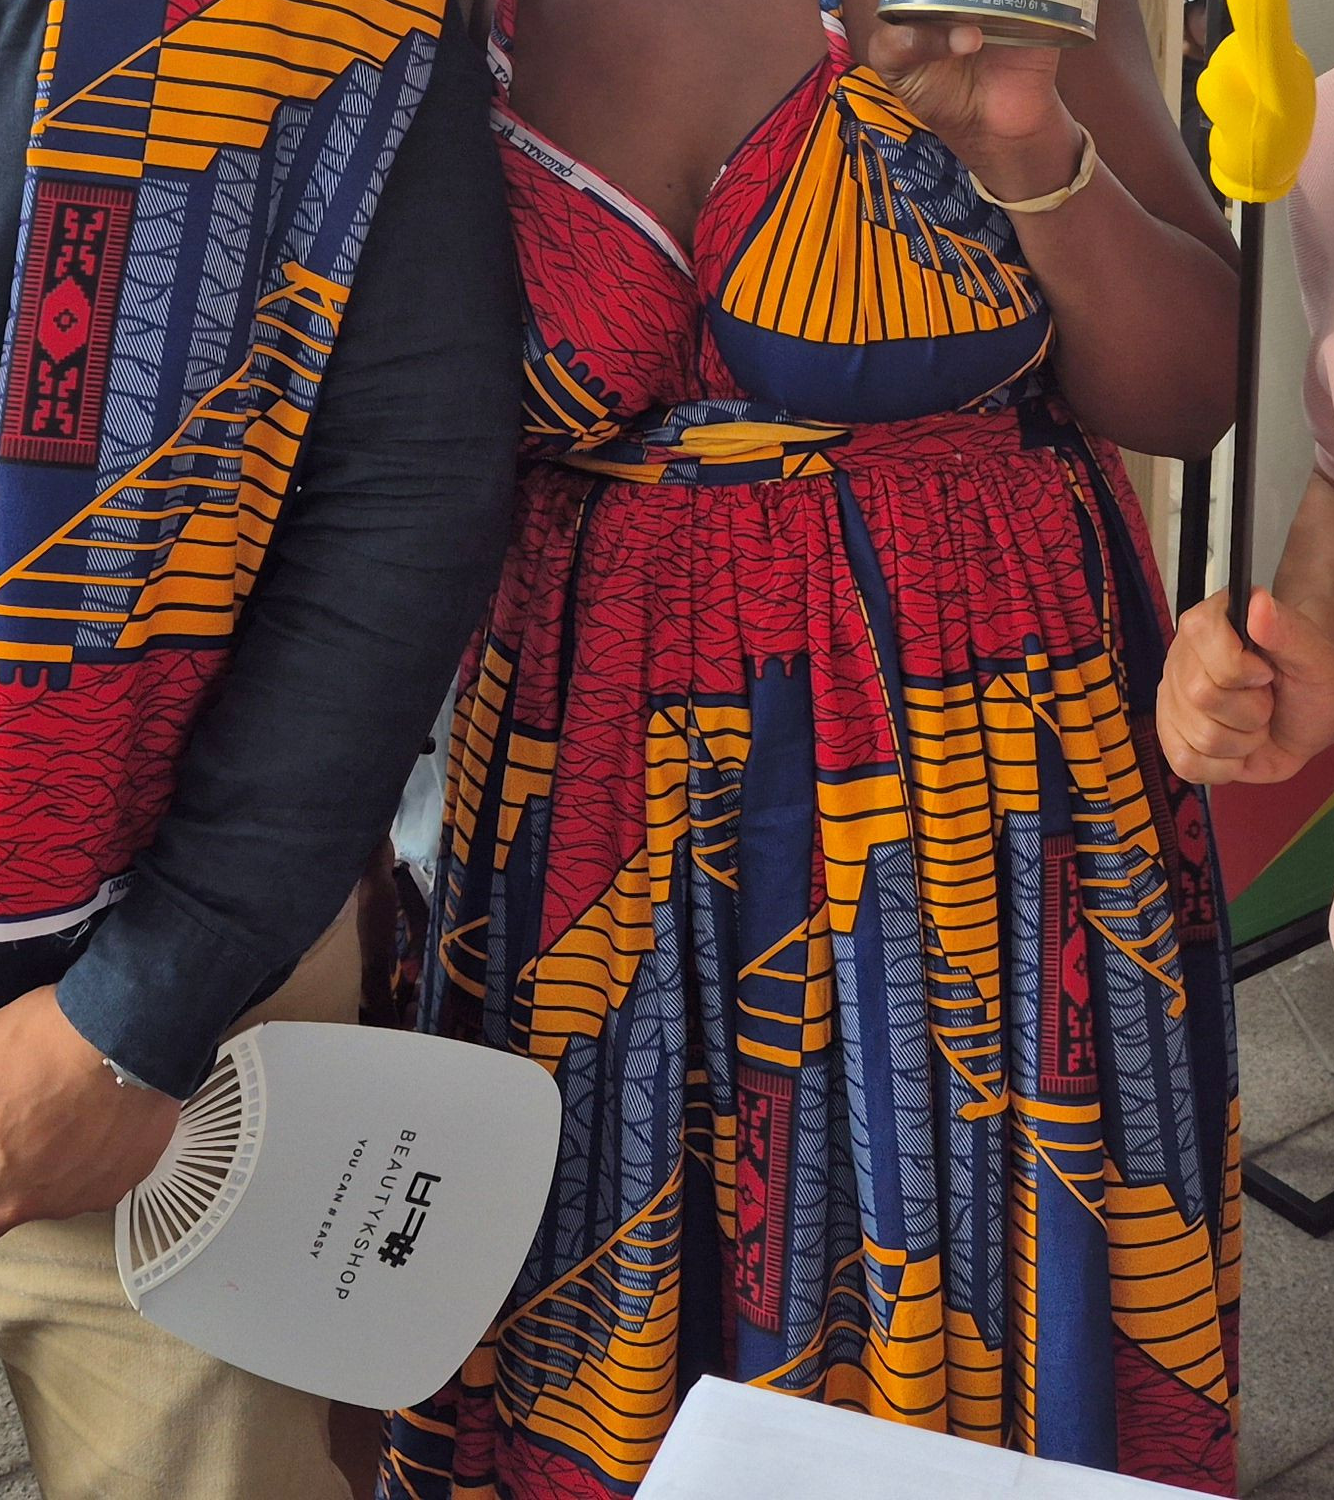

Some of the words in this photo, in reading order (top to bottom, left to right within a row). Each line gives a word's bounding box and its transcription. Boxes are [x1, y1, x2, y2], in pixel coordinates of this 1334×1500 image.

[521, 137, 575, 179] ORIGINAL
[348, 1139, 368, 1168] YOU
[333, 1173, 352, 1203] CAN
[335, 1128, 417, 1300] BEAUTYKSHOP
[309, 1221, 332, 1260] EASY
